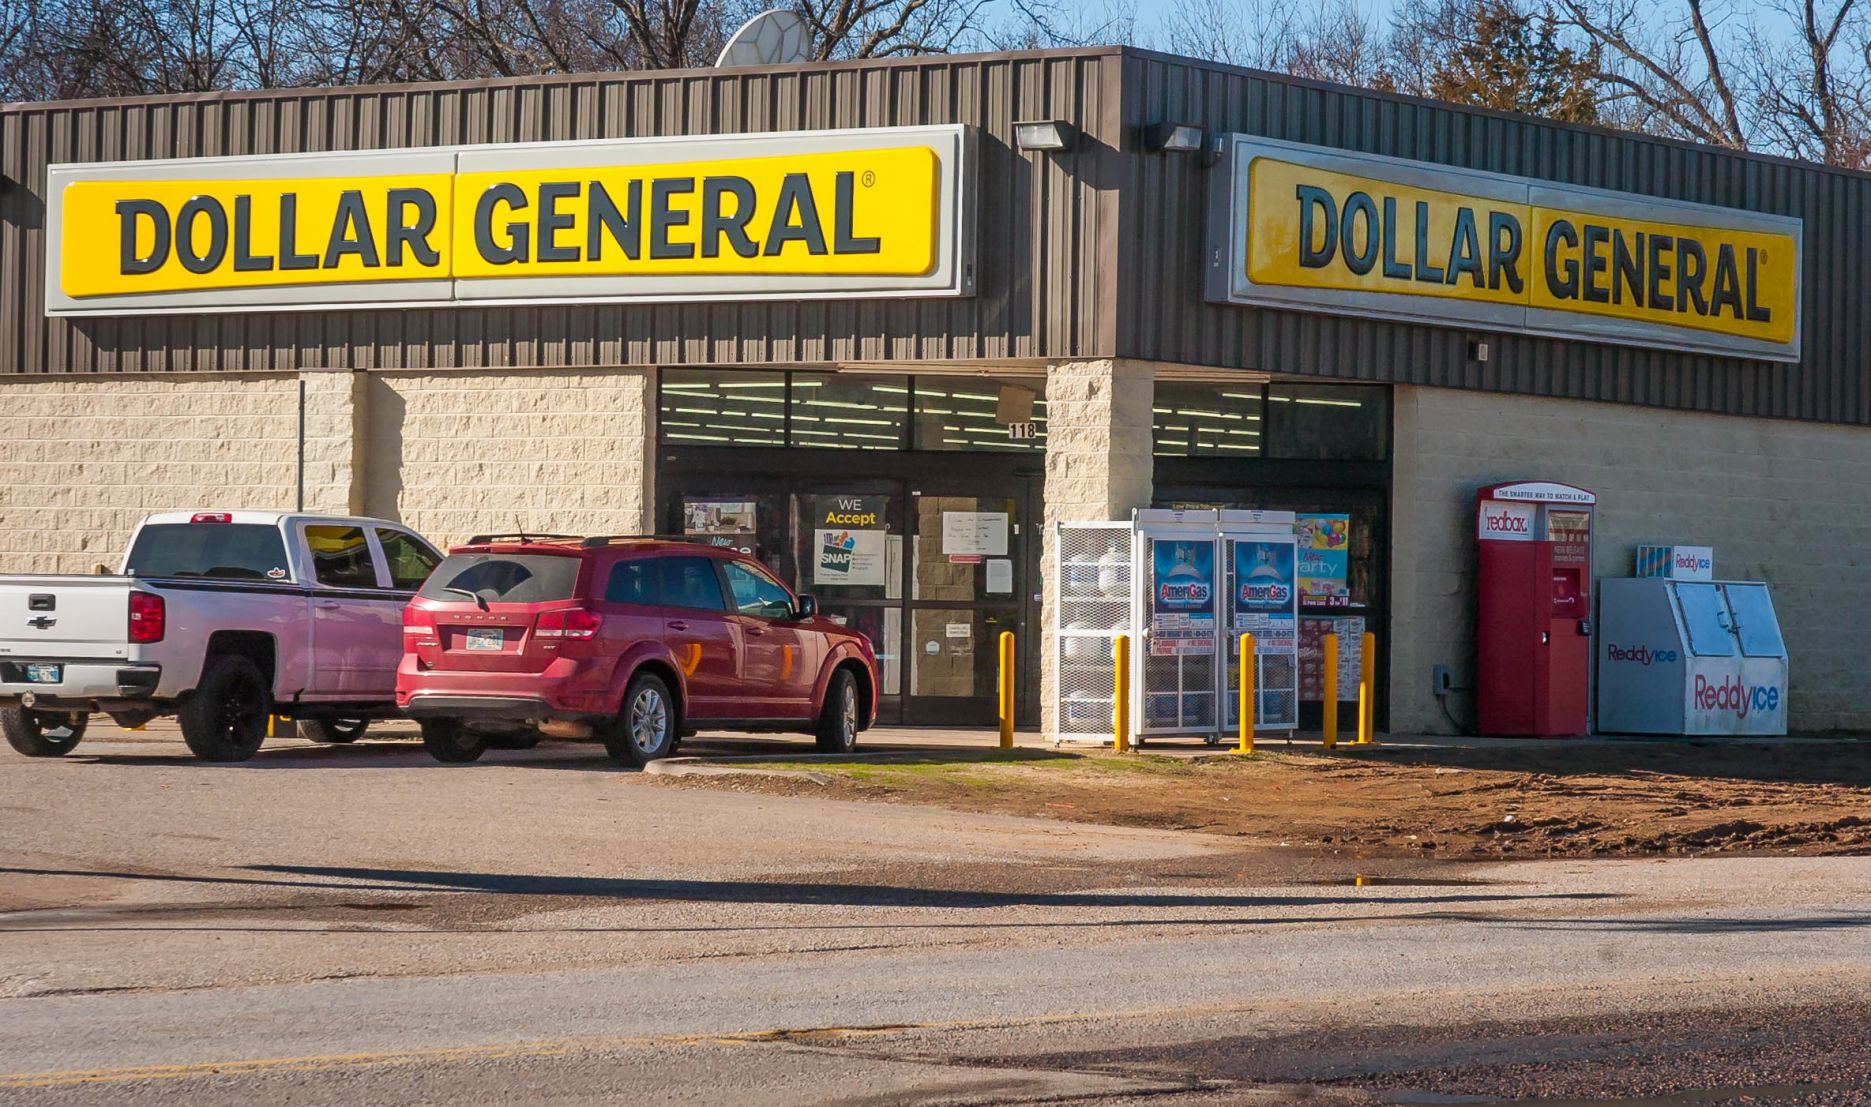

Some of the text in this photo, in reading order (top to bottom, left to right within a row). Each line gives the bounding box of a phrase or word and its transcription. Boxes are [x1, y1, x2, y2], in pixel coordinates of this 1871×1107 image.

[115, 186, 441, 277] DOLLAR
[472, 170, 881, 265] GENERAL
[1296, 184, 1524, 294] DOLLAR
[1544, 219, 1771, 323] GENERAL
[1010, 423, 1035, 438] 118
[838, 499, 862, 511] WE
[825, 511, 876, 526] Accept
[821, 553, 851, 564] SNAP
[1298, 560, 1338, 577] arty
[1161, 583, 1207, 600] AmeriGas
[1242, 583, 1288, 600] AmeriGas
